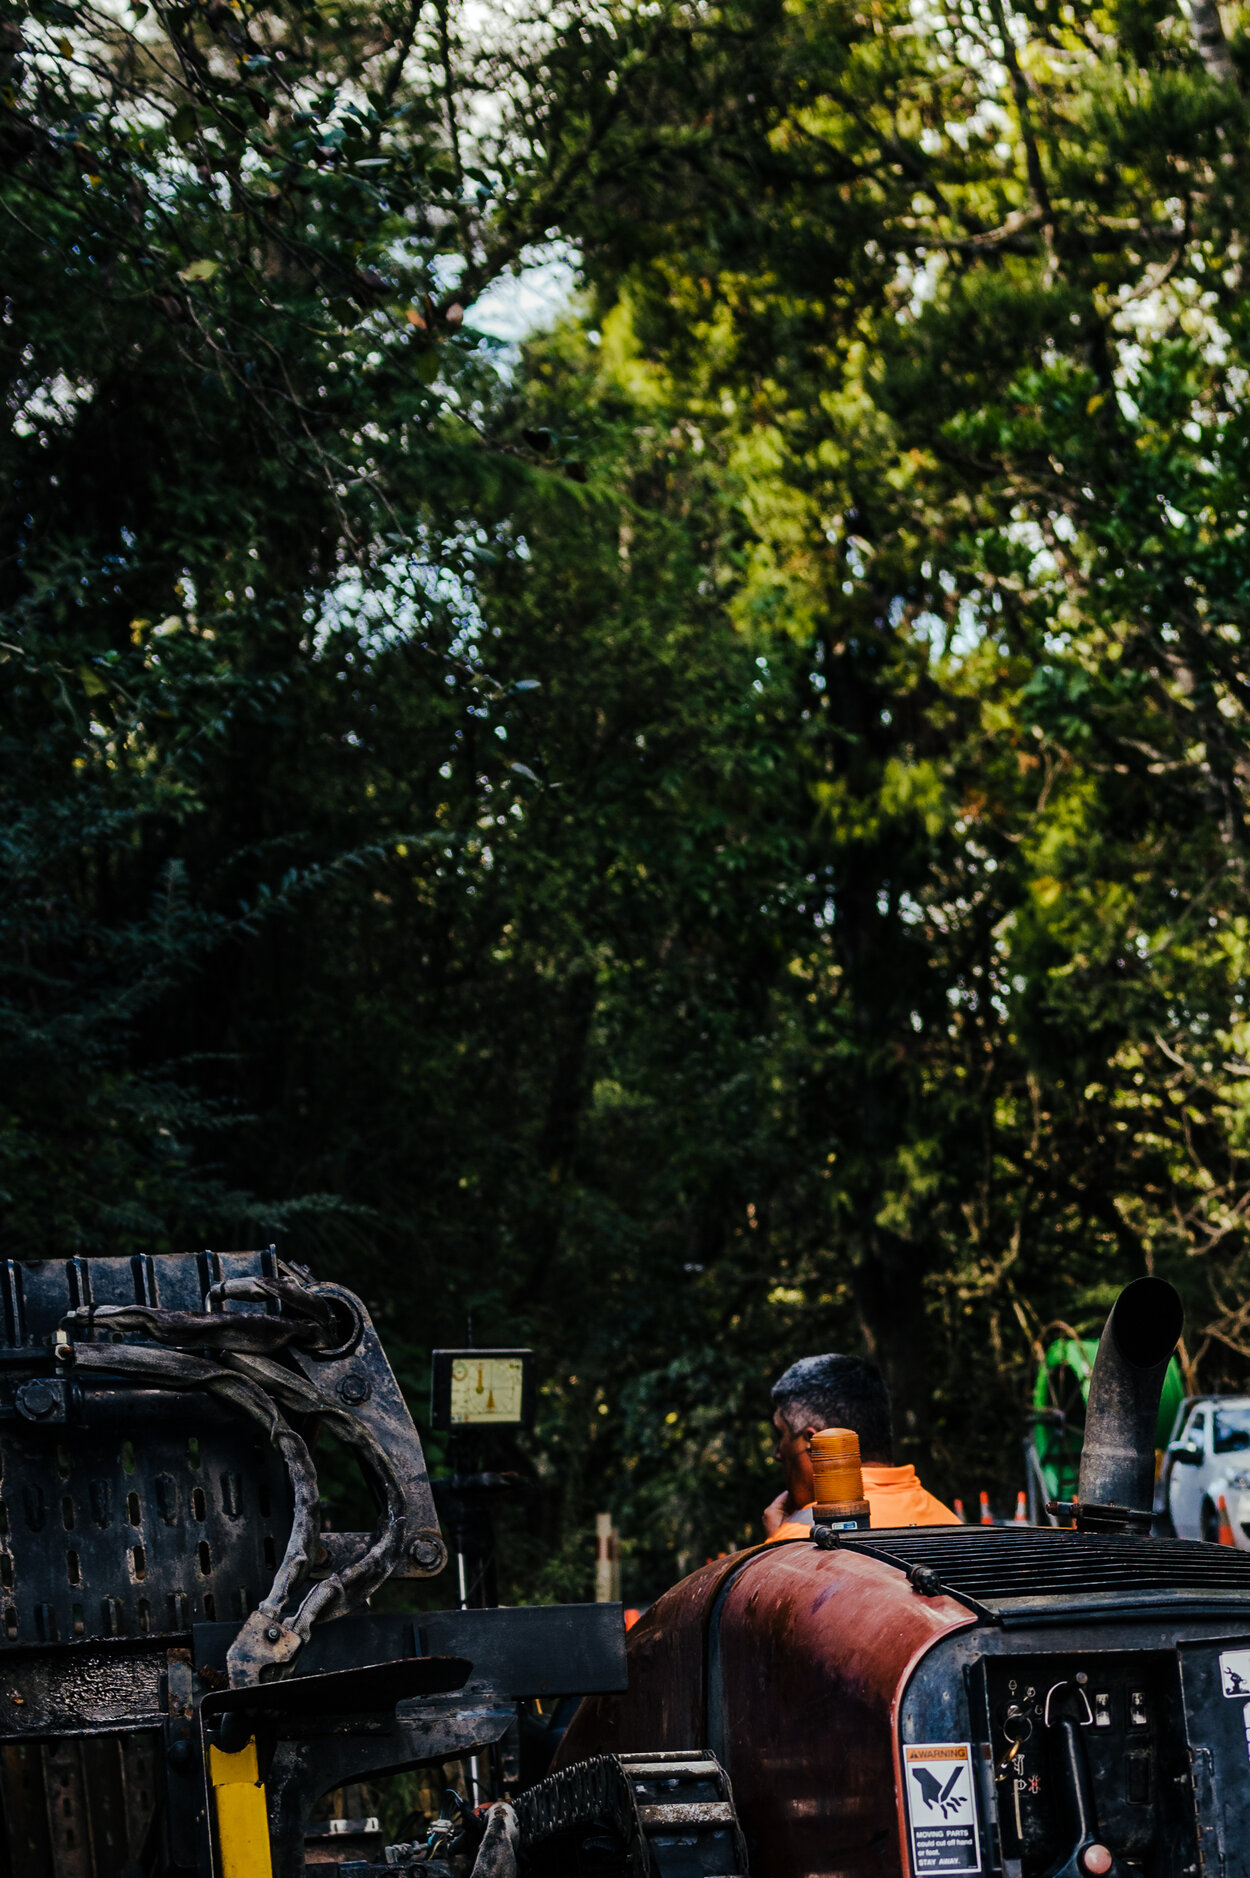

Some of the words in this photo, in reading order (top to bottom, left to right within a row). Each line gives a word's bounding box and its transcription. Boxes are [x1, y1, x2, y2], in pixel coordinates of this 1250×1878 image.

[919, 1748, 965, 1759] WARNING
[916, 1830, 944, 1839] MOVING
[946, 1829, 969, 1838] PARTS
[916, 1839, 935, 1848] could
[935, 1839, 946, 1847] cut
[946, 1838, 955, 1847] off
[956, 1838, 973, 1846] hand
[918, 1858, 936, 1867] STAY
[938, 1857, 961, 1866] AWAY.
